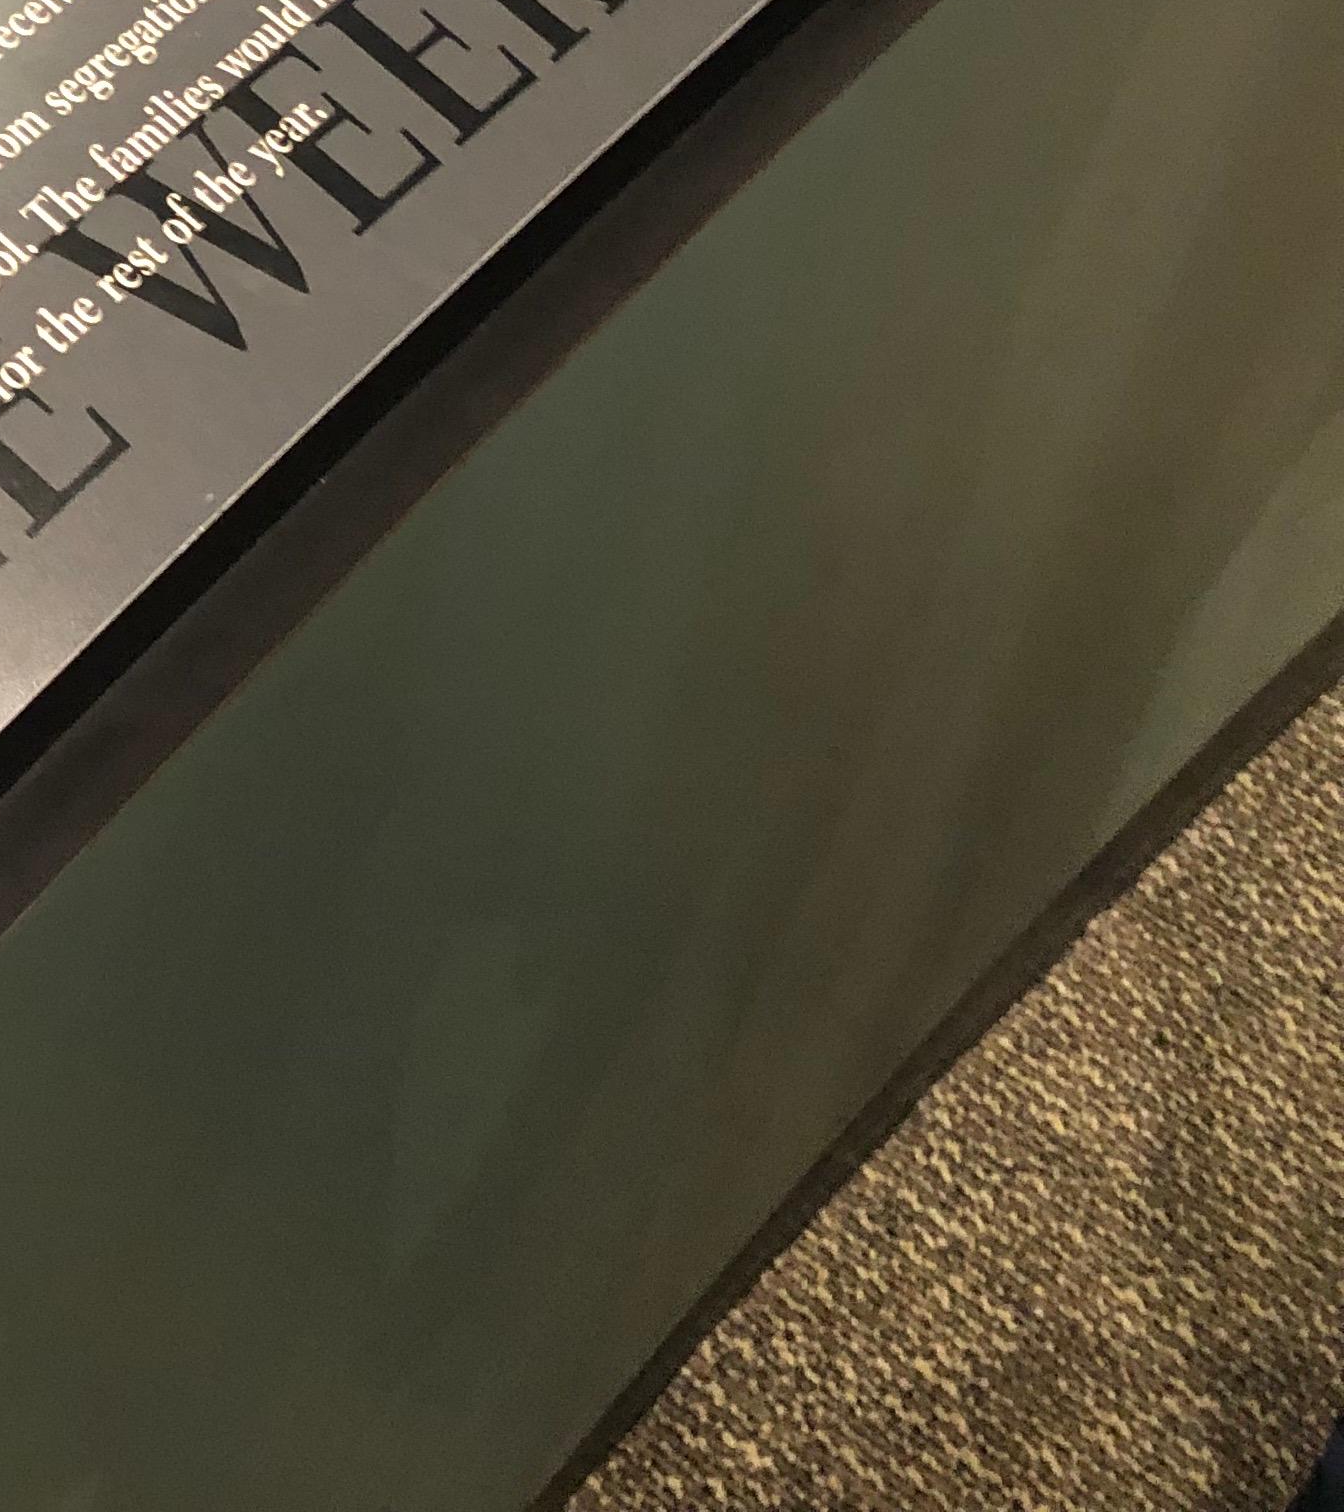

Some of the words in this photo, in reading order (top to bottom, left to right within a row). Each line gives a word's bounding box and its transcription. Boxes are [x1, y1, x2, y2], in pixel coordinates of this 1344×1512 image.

[18, 177, 103, 233] The
[88, 75, 224, 181] families
[35, 297, 101, 353] the
[97, 236, 167, 302] rest
[162, 192, 202, 243] of
[193, 161, 255, 212] the
[247, 102, 327, 176] year.
